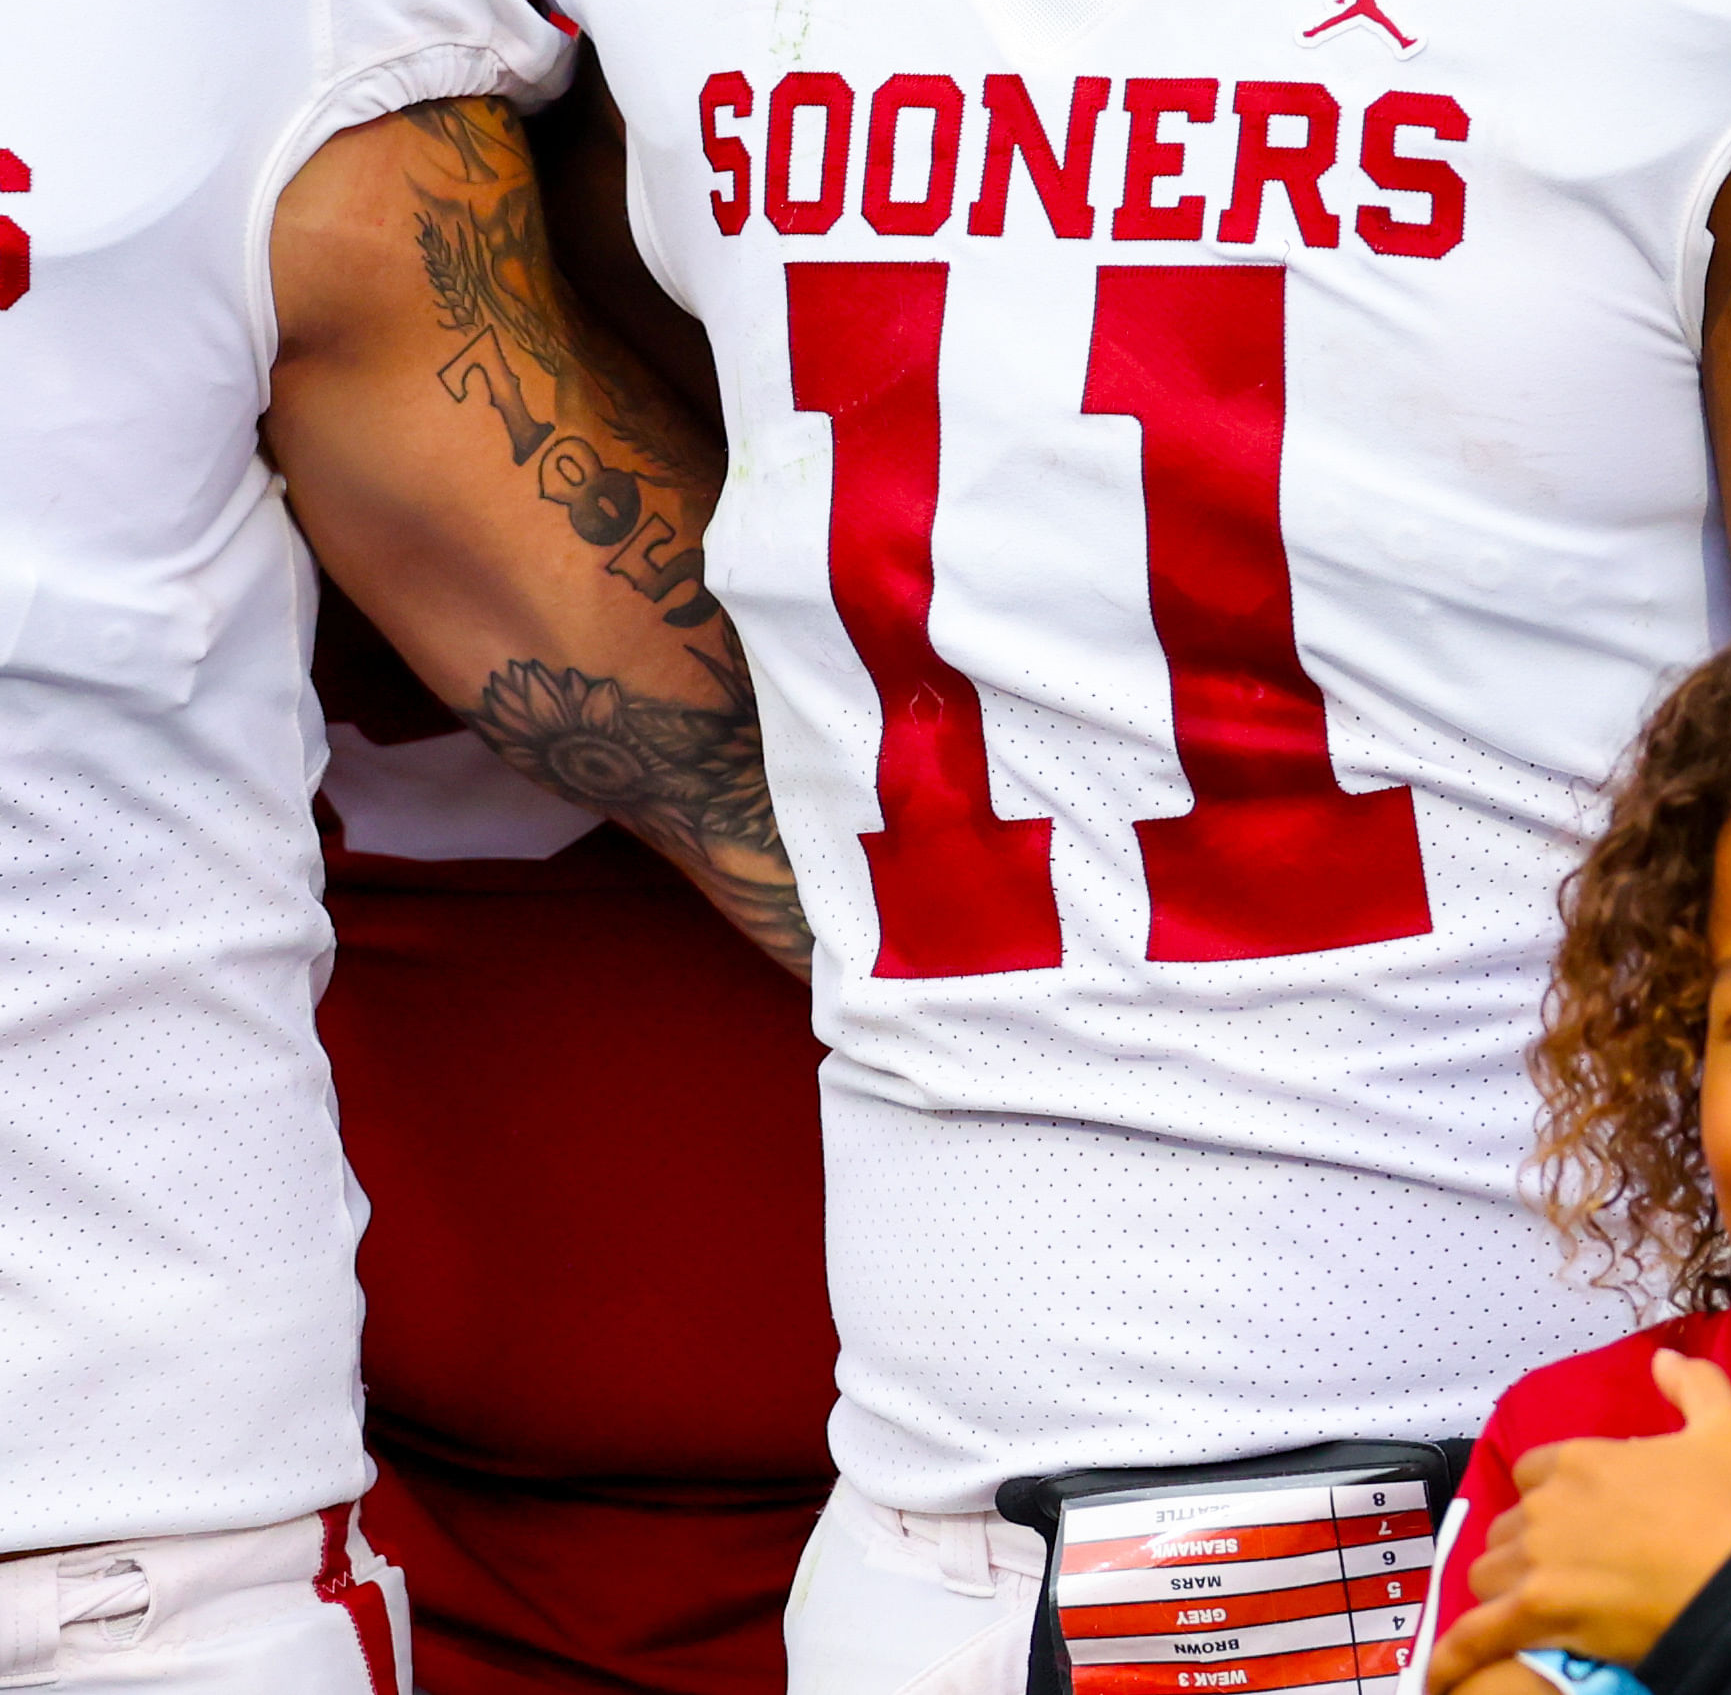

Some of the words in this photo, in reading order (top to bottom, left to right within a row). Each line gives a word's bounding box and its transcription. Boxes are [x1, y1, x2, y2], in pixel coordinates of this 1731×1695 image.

[698, 70, 1472, 260] SOONERS
[437, 323, 720, 628] 785
[784, 261, 1434, 978] 11
[1373, 1492, 1386, 1507] 8
[1378, 1520, 1392, 1535] 7
[1382, 1550, 1396, 1565] 6
[1170, 1575, 1222, 1591] MARS
[1386, 1581, 1402, 1599] 5
[1176, 1607, 1228, 1626] GREY
[1392, 1615, 1405, 1631] 4
[1174, 1638, 1240, 1654] BROWN
[1395, 1647, 1410, 1666] 3
[1177, 1671, 1191, 1687] 3
[1193, 1669, 1248, 1687] WEAK
